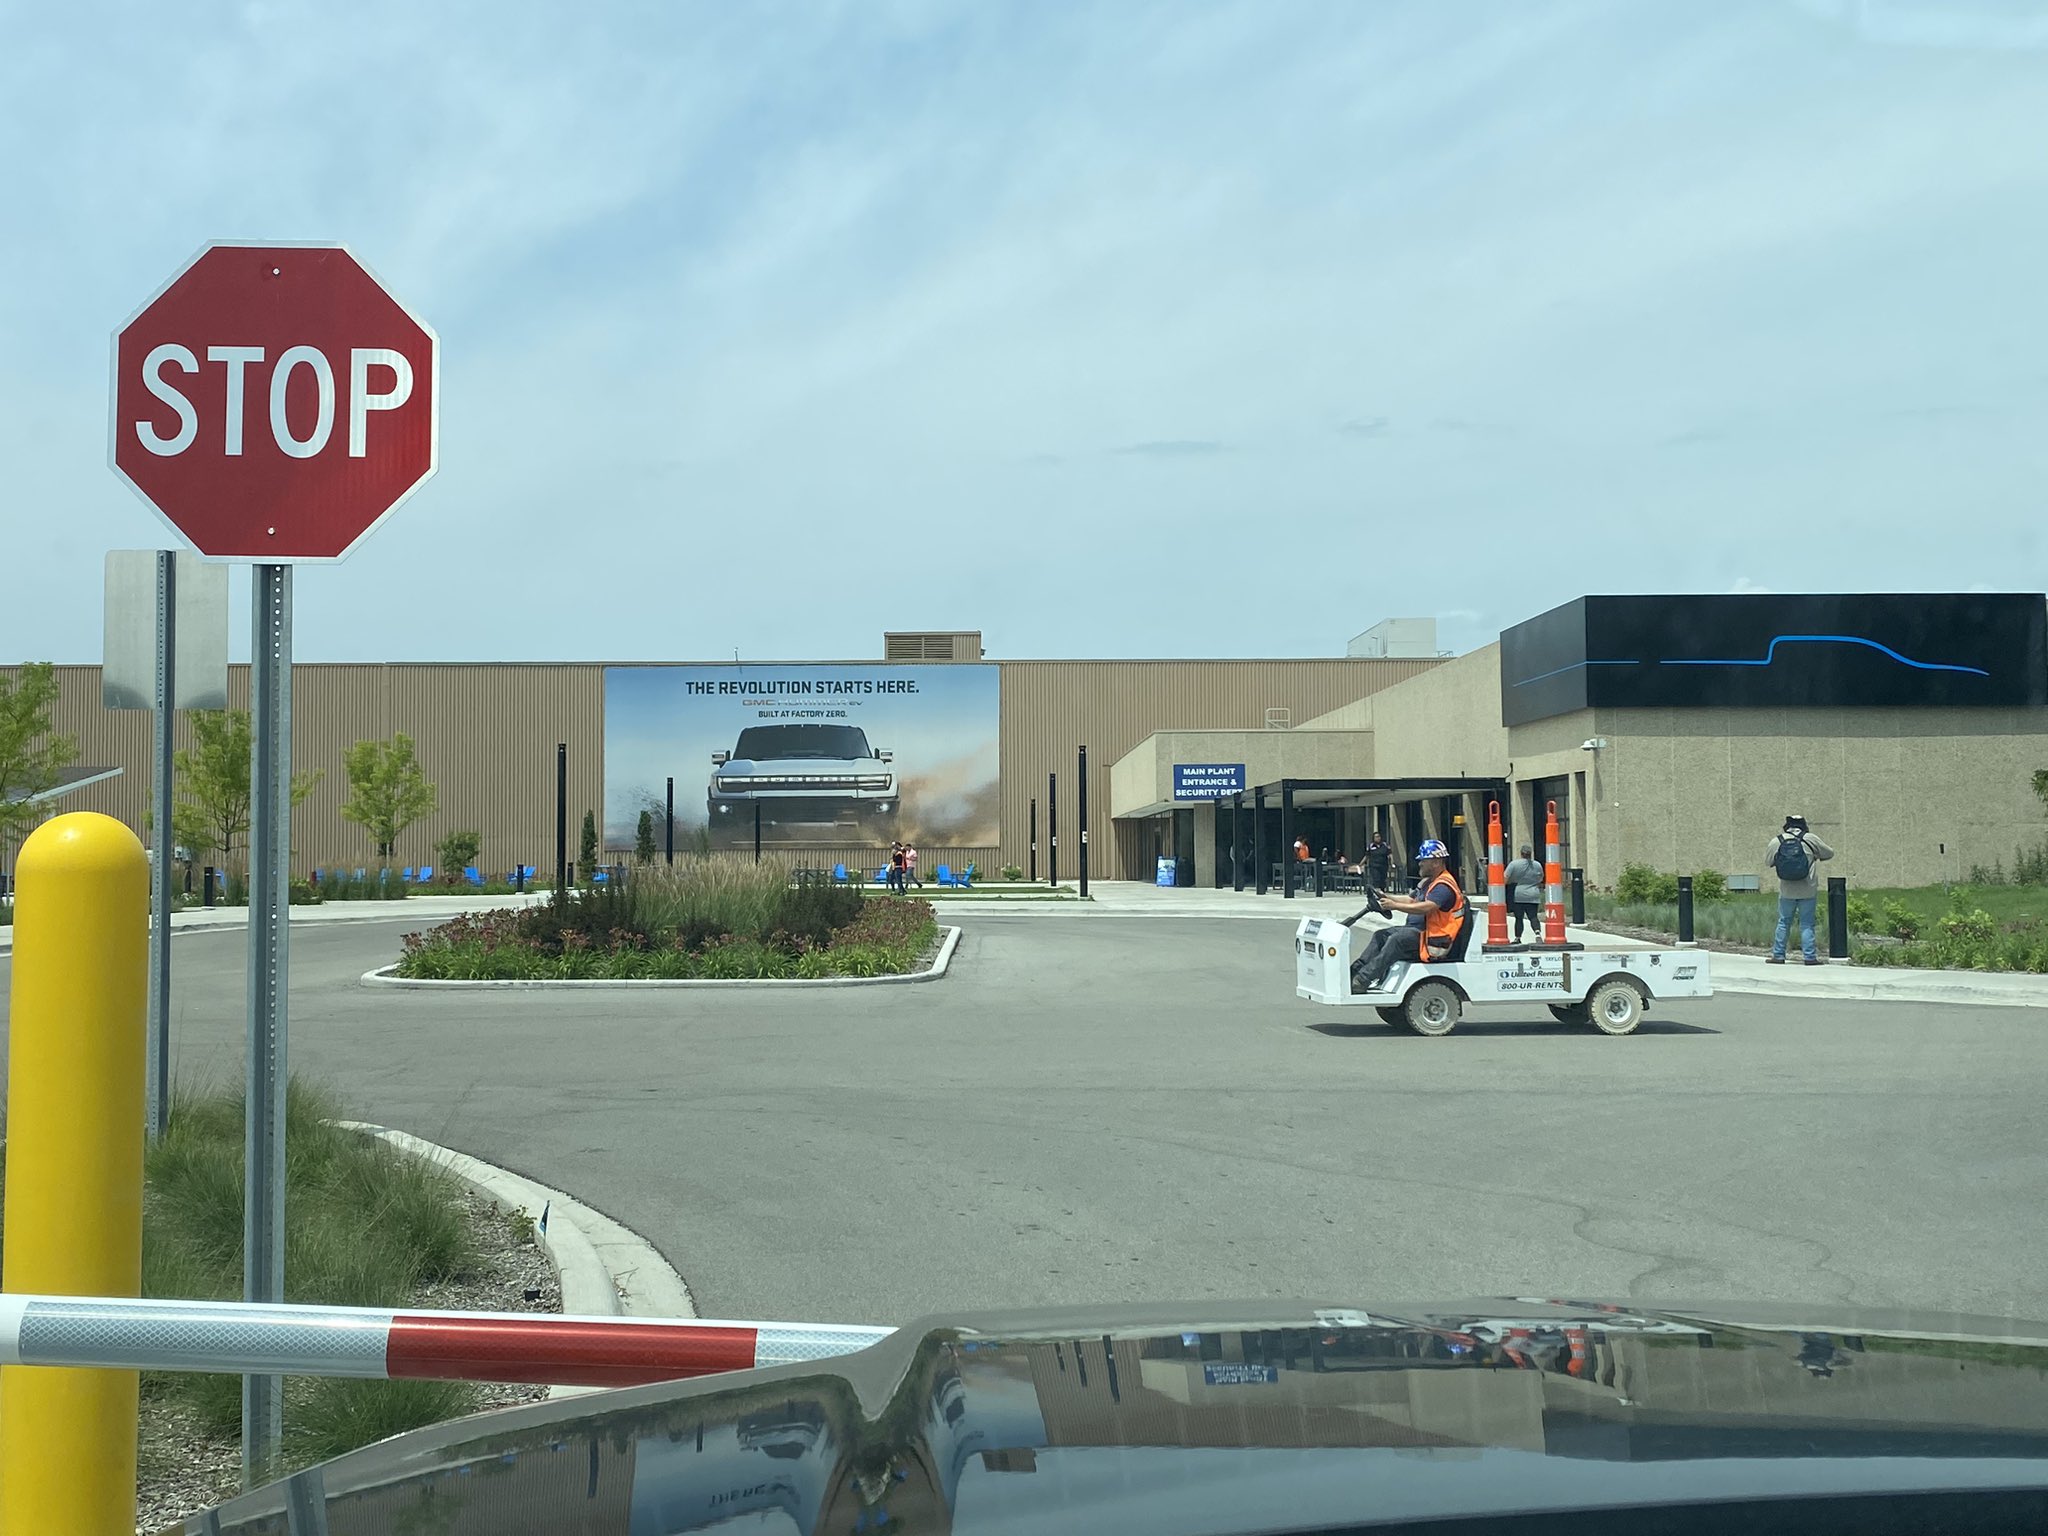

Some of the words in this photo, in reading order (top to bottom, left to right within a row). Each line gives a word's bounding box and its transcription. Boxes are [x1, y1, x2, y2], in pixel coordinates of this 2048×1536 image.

[135, 343, 413, 459] STOP
[686, 681, 714, 694] THE
[719, 681, 811, 695] REVOLUTION
[816, 681, 872, 694] STARTS
[877, 680, 920, 694] HERE.
[758, 710, 778, 718] BUILT
[780, 710, 791, 718] AT
[792, 710, 825, 718] FACTORY
[826, 710, 848, 718] ZERO.
[1175, 789, 1219, 797] SECURITY
[1511, 970, 1536, 978] Uted
